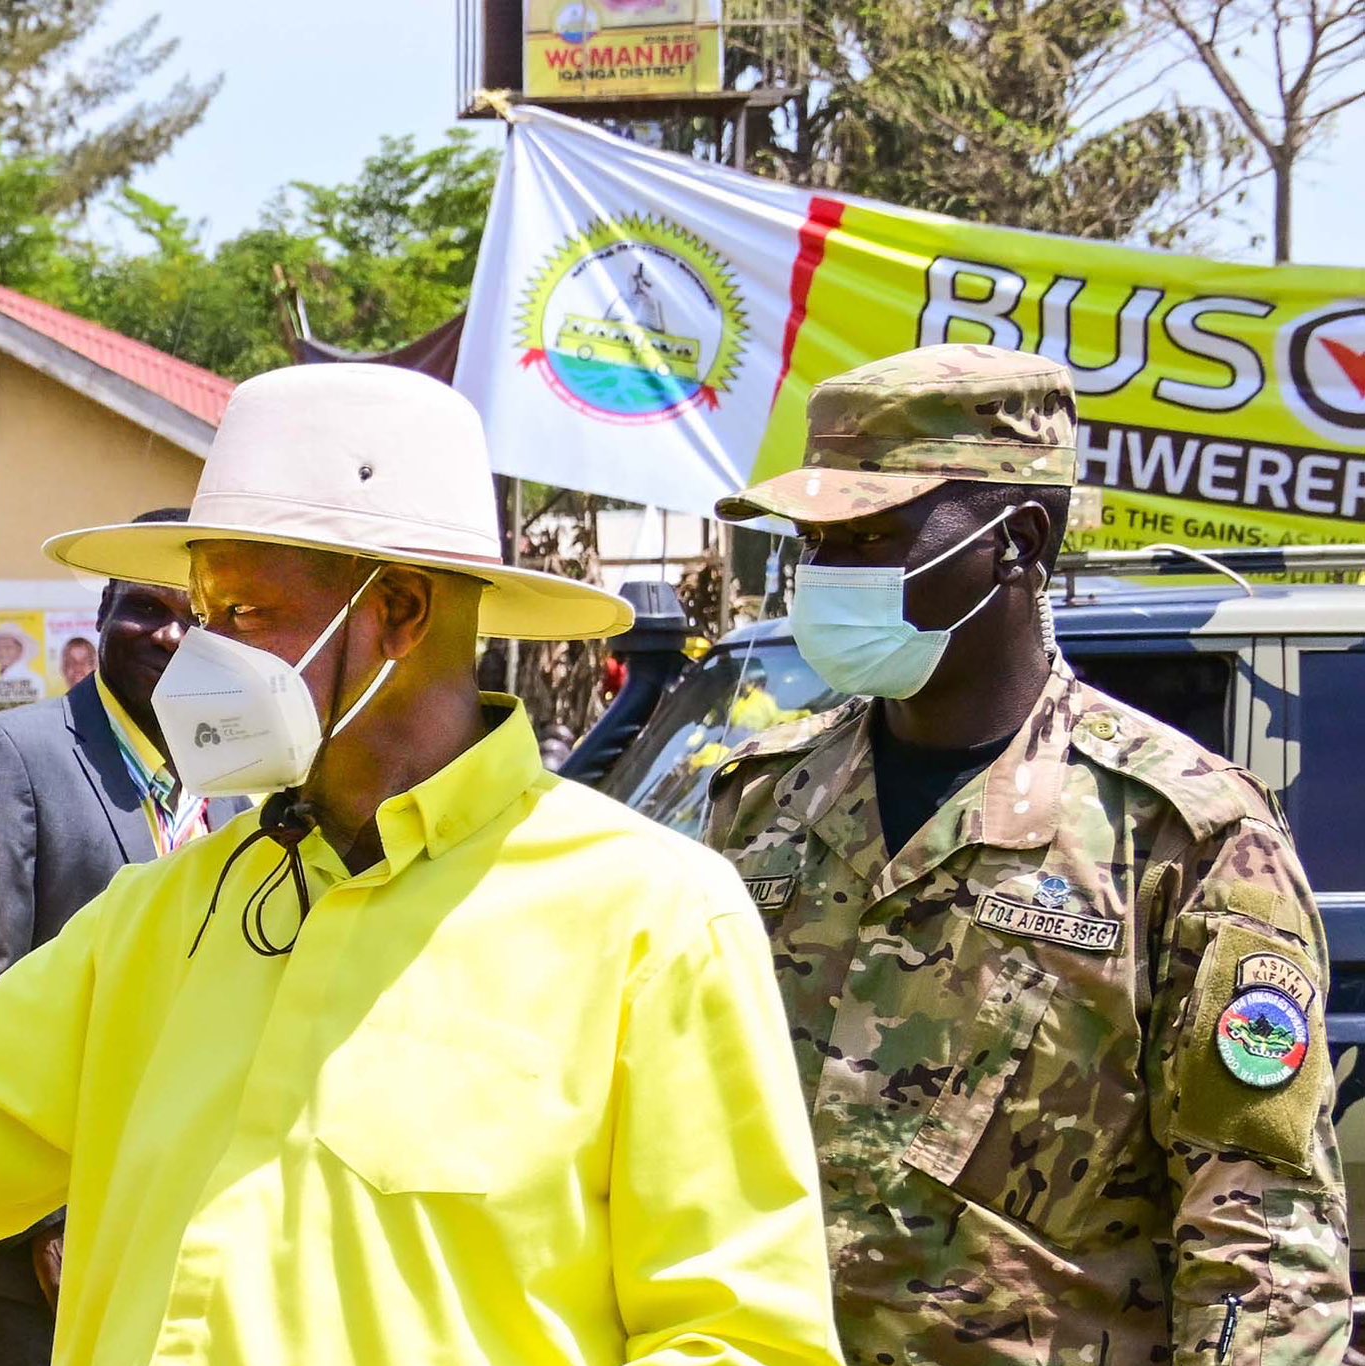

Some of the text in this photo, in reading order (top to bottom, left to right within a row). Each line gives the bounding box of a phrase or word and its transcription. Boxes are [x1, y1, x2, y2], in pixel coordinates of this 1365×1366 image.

[545, 45, 653, 69] WOMAN
[620, 65, 686, 78] DISTRICT
[1126, 508, 1174, 534] THE
[987, 903, 1110, 944] 704 A/BDE-3SFG
[1252, 970, 1303, 1000] KIFANI
[1259, 958, 1302, 986] ASIYE
